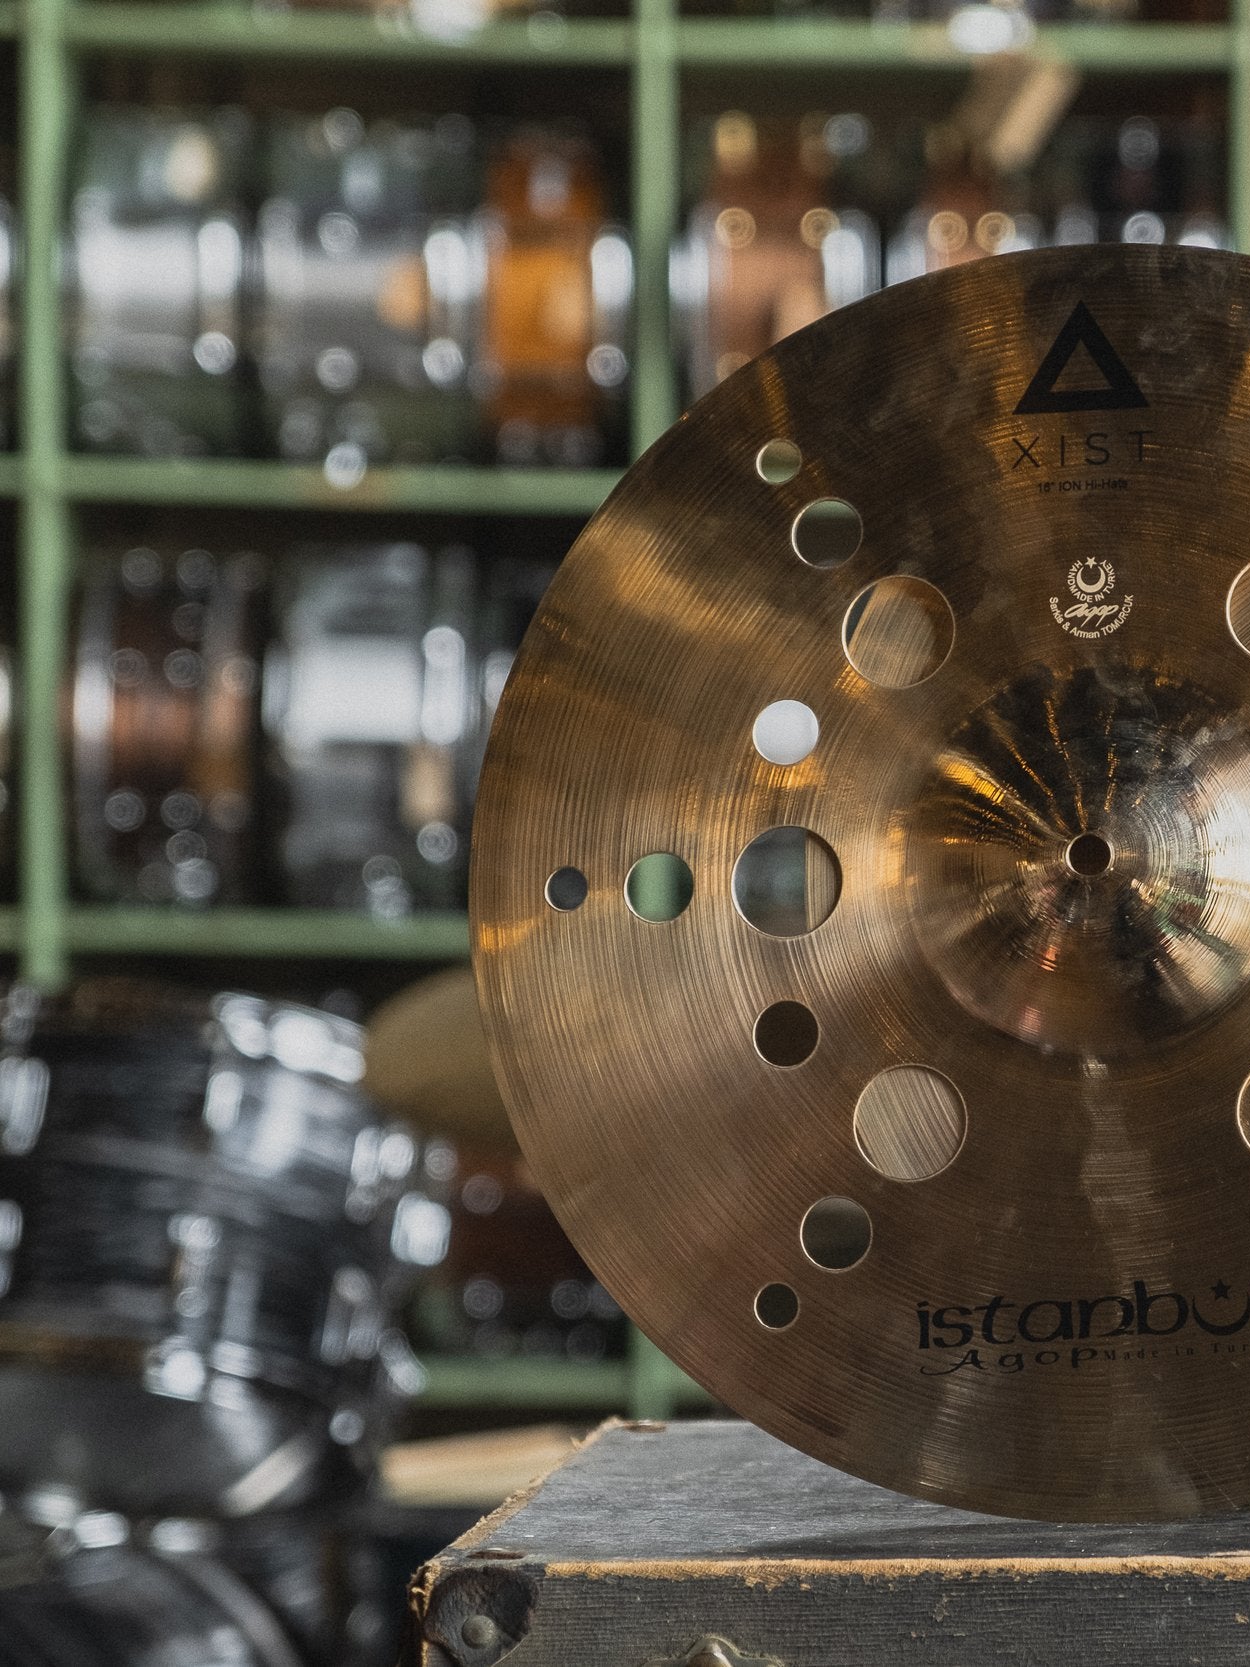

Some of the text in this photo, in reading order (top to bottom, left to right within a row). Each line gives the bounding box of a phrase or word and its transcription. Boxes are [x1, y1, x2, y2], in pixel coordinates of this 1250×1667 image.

[1012, 430, 1154, 470] XIST
[1059, 480, 1081, 492] ION
[1067, 560, 1116, 603] HANDMADE IN TURKEY
[1062, 621, 1071, 631] &
[1069, 627, 1100, 639] Arman
[1101, 594, 1134, 636] TOMURCUK
[919, 1348, 1098, 1376] Agop
[1104, 1348, 1160, 1361] Made
[1175, 1345, 1194, 1356] in
